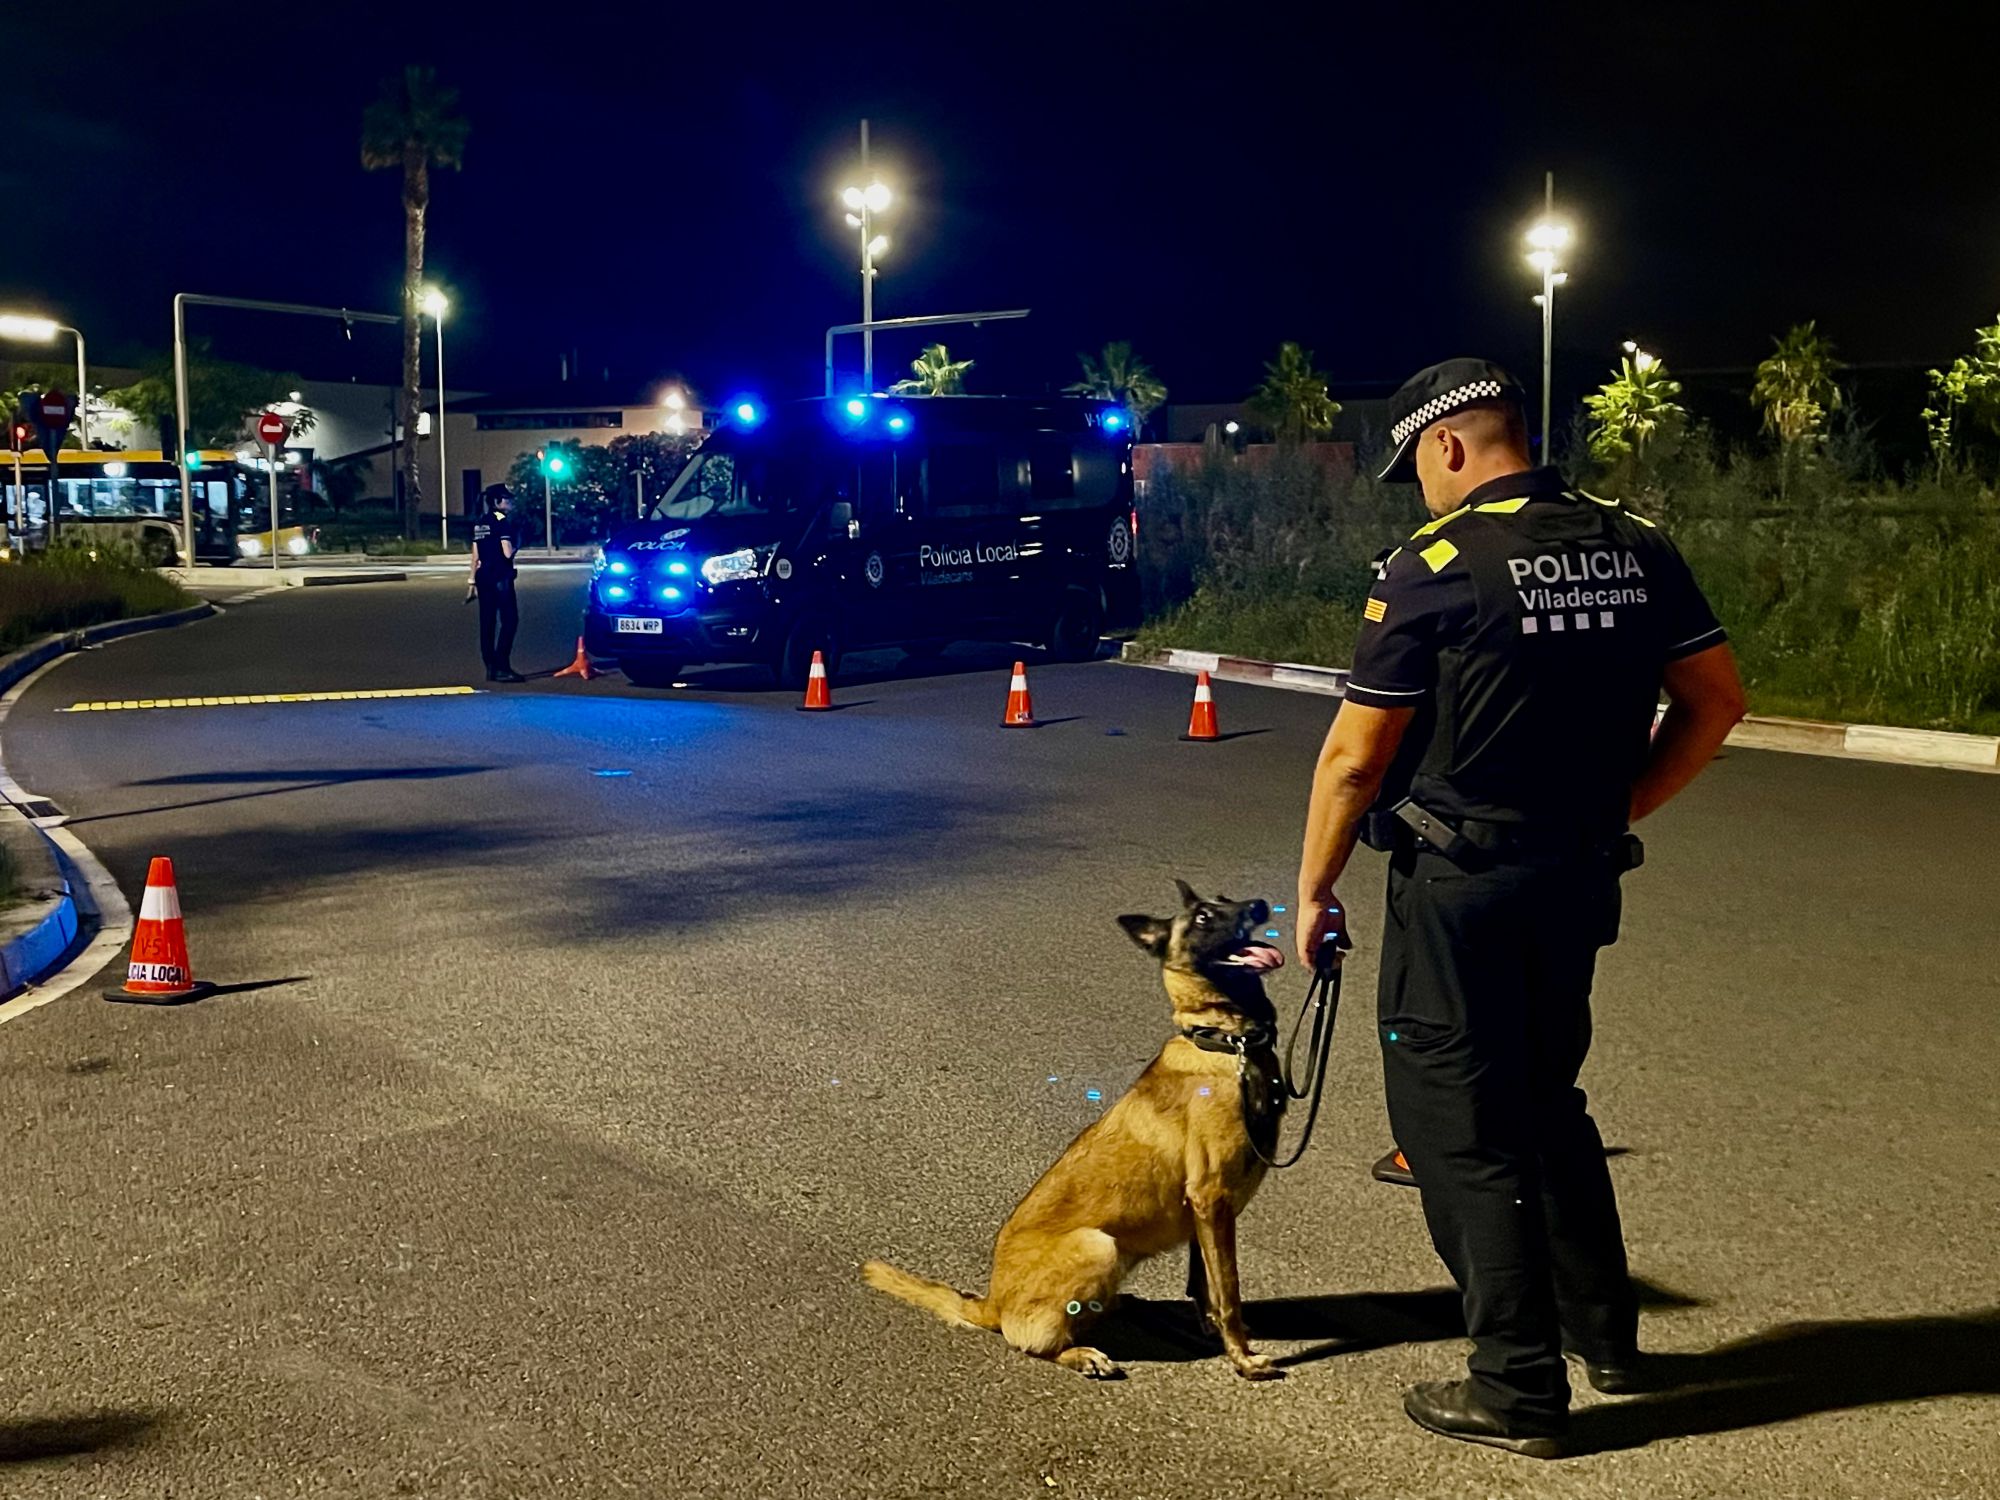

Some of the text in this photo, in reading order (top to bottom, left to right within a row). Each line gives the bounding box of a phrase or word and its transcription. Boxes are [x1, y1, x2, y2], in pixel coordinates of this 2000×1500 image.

[976, 538, 1018, 563] Local
[1507, 550, 1644, 585] POLICIA
[1518, 586, 1647, 610] Viladecans
[620, 620, 641, 631] 8634
[127, 964, 147, 981] CIA
